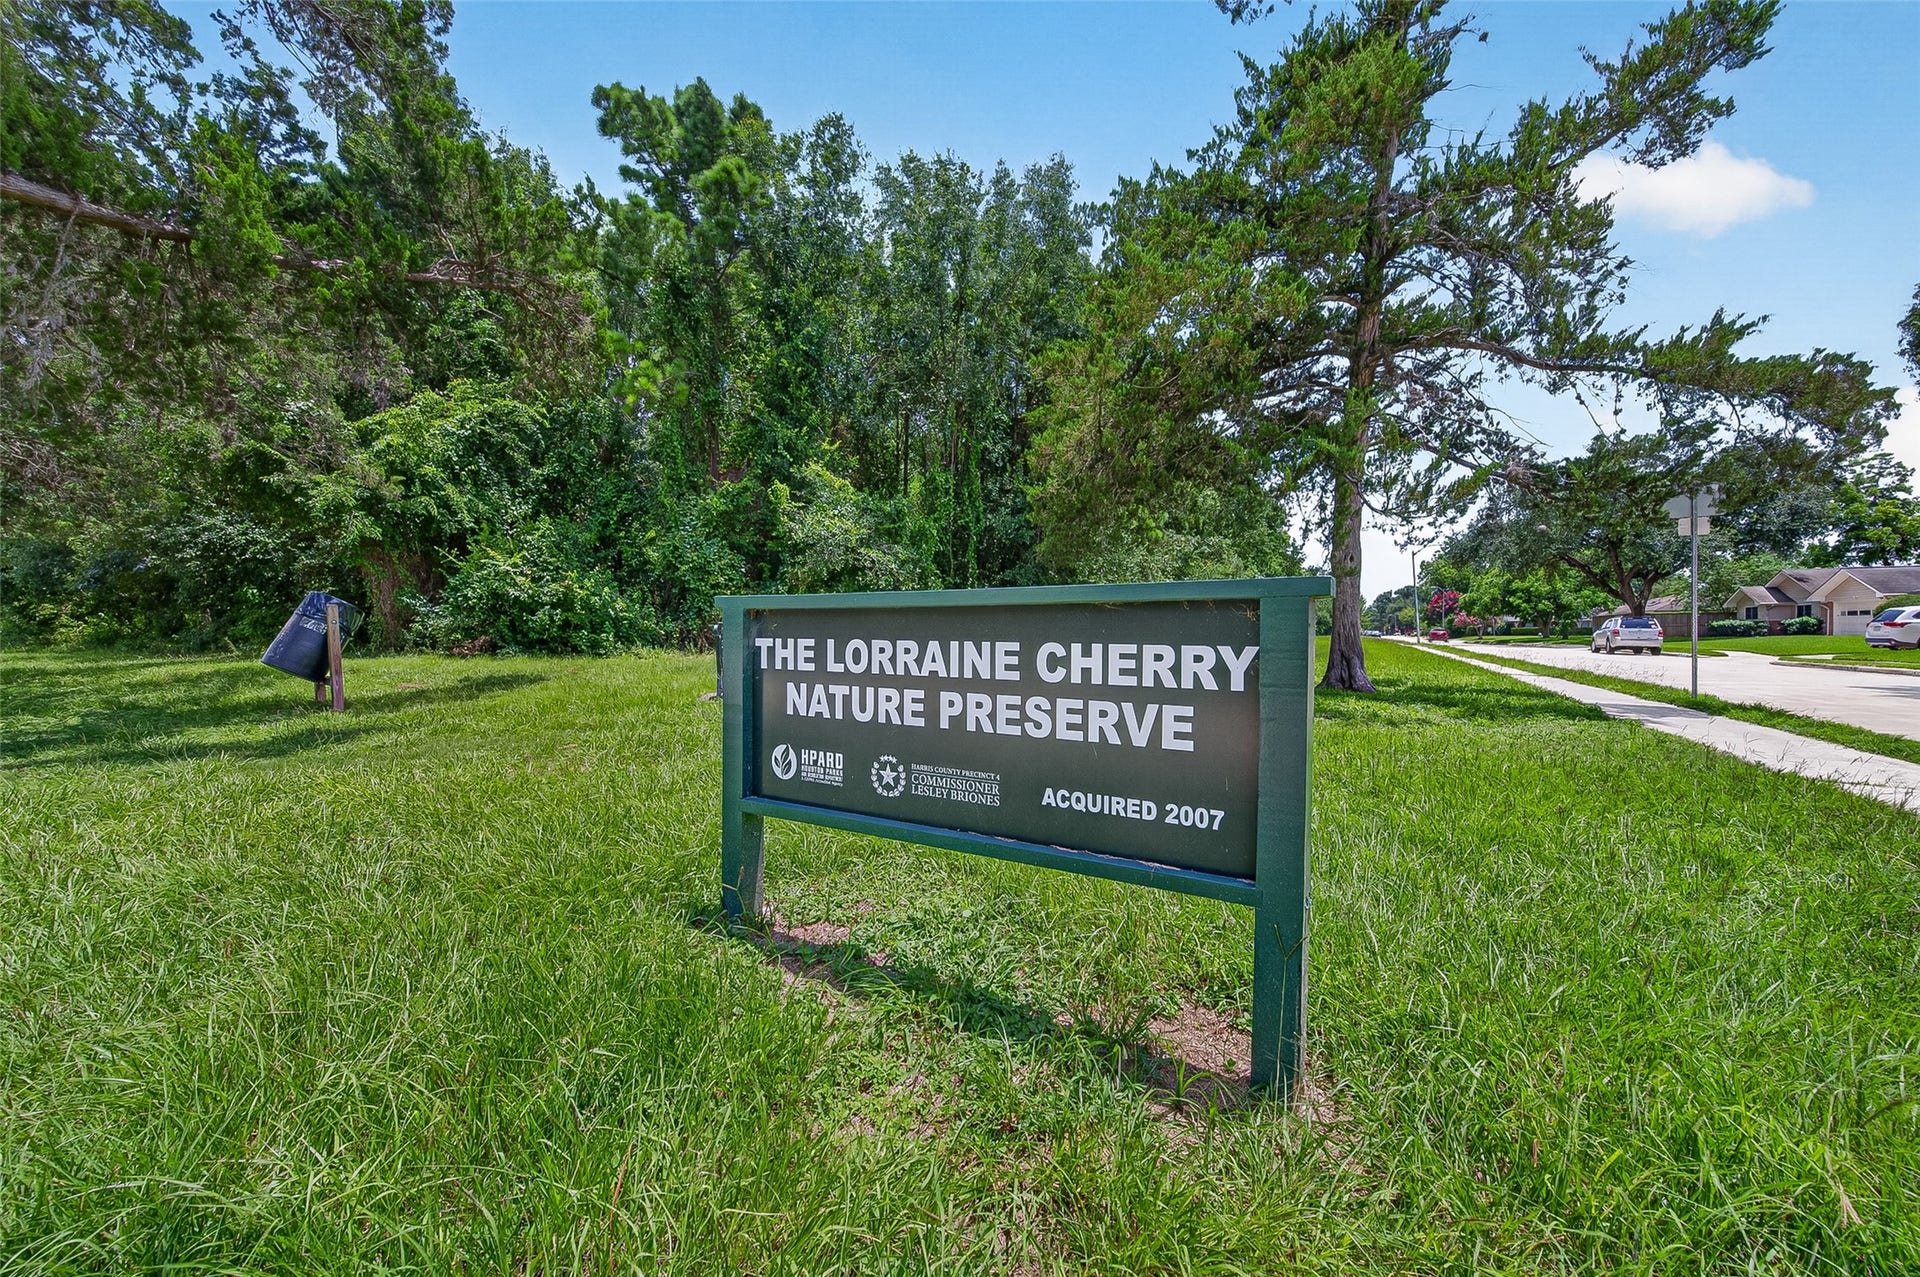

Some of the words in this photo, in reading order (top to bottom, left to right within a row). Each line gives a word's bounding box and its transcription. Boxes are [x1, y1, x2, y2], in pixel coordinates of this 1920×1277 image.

[755, 637, 815, 671] THE
[826, 638, 1020, 681] LORRAINE
[1036, 642, 1260, 691] CHERRY
[786, 682, 925, 727] NATURE
[939, 691, 1194, 751] PRESERVE
[801, 749, 843, 769] HPARD
[911, 763, 933, 772] HARRIS
[934, 766, 961, 776] COUNTY
[961, 769, 995, 780] PRECINCT
[911, 773, 1000, 795] COMMISSIONER
[911, 784, 949, 799] LESLEY
[950, 789, 1000, 807] BRIONES
[1041, 787, 1158, 821] ACQUIRED
[1164, 803, 1225, 831] 2007
